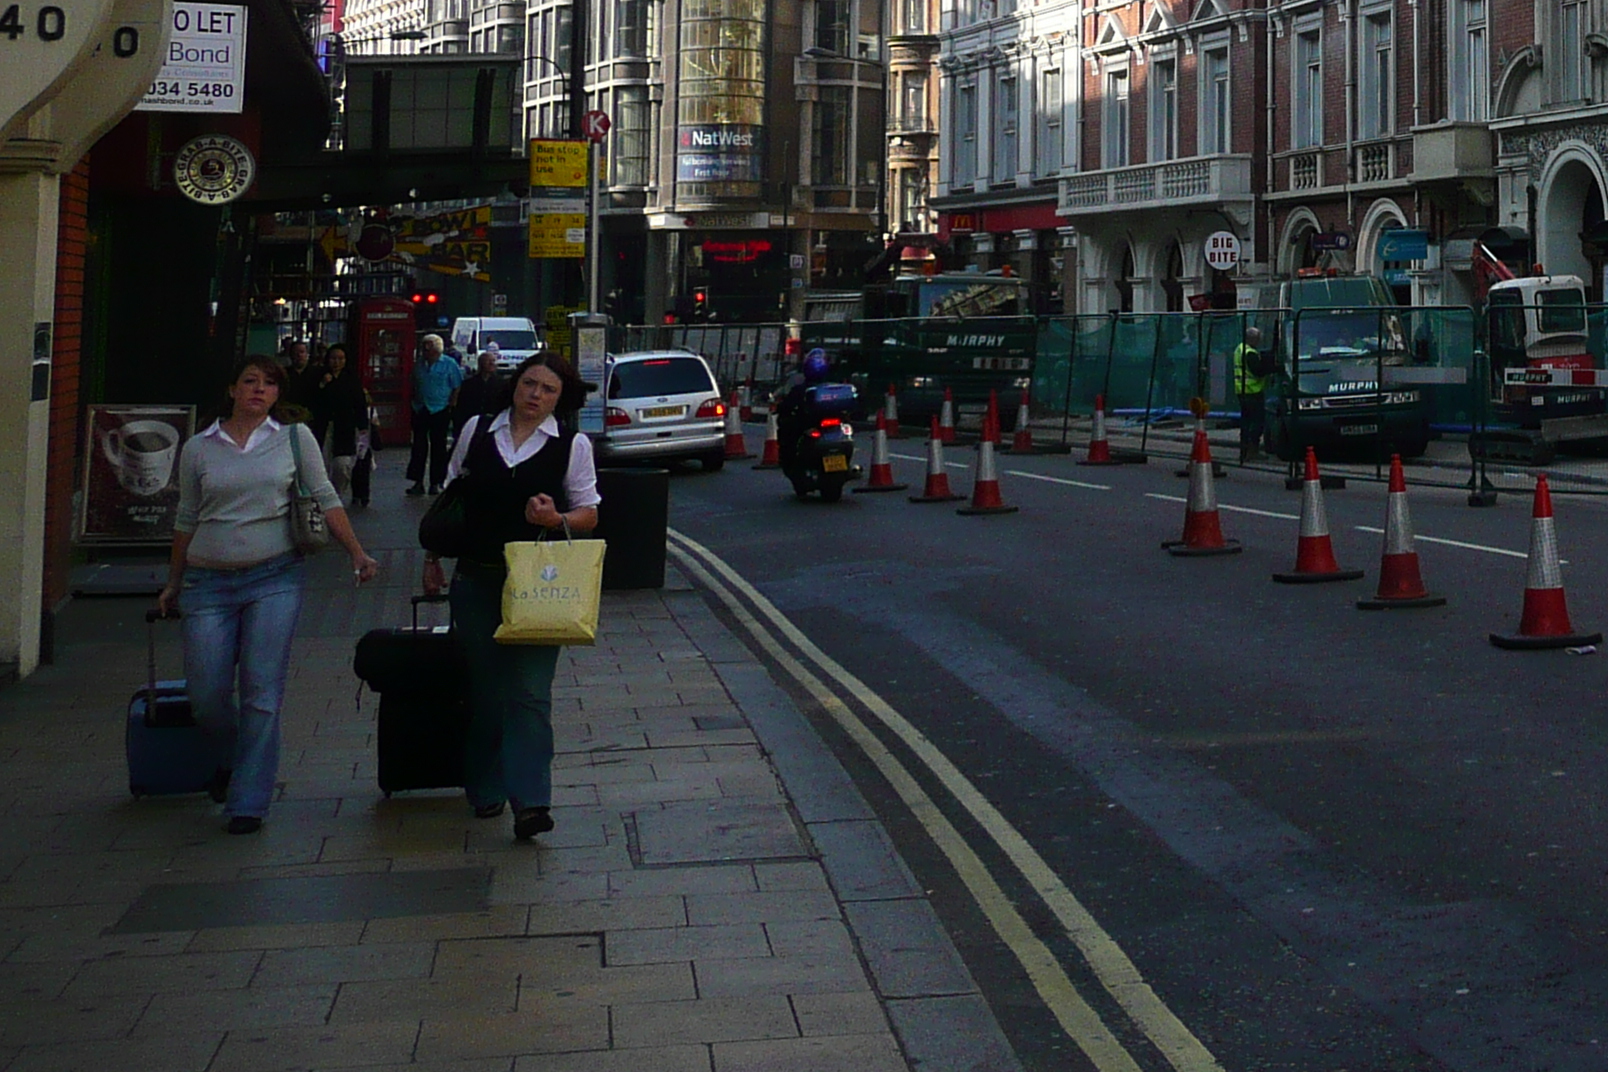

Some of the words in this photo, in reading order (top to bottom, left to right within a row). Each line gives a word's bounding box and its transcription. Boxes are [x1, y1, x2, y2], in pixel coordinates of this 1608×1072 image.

[197, 11, 237, 34] LET
[169, 41, 231, 64] Bond
[187, 82, 234, 97] 5480
[588, 114, 605, 134] K
[692, 130, 754, 147] NatWest
[537, 145, 555, 154] Bus
[557, 145, 580, 156] stop
[536, 155, 554, 164] not
[556, 155, 566, 164] in
[536, 165, 554, 174] use
[1212, 238, 1233, 249] BIG
[1209, 252, 1237, 263] BITE
